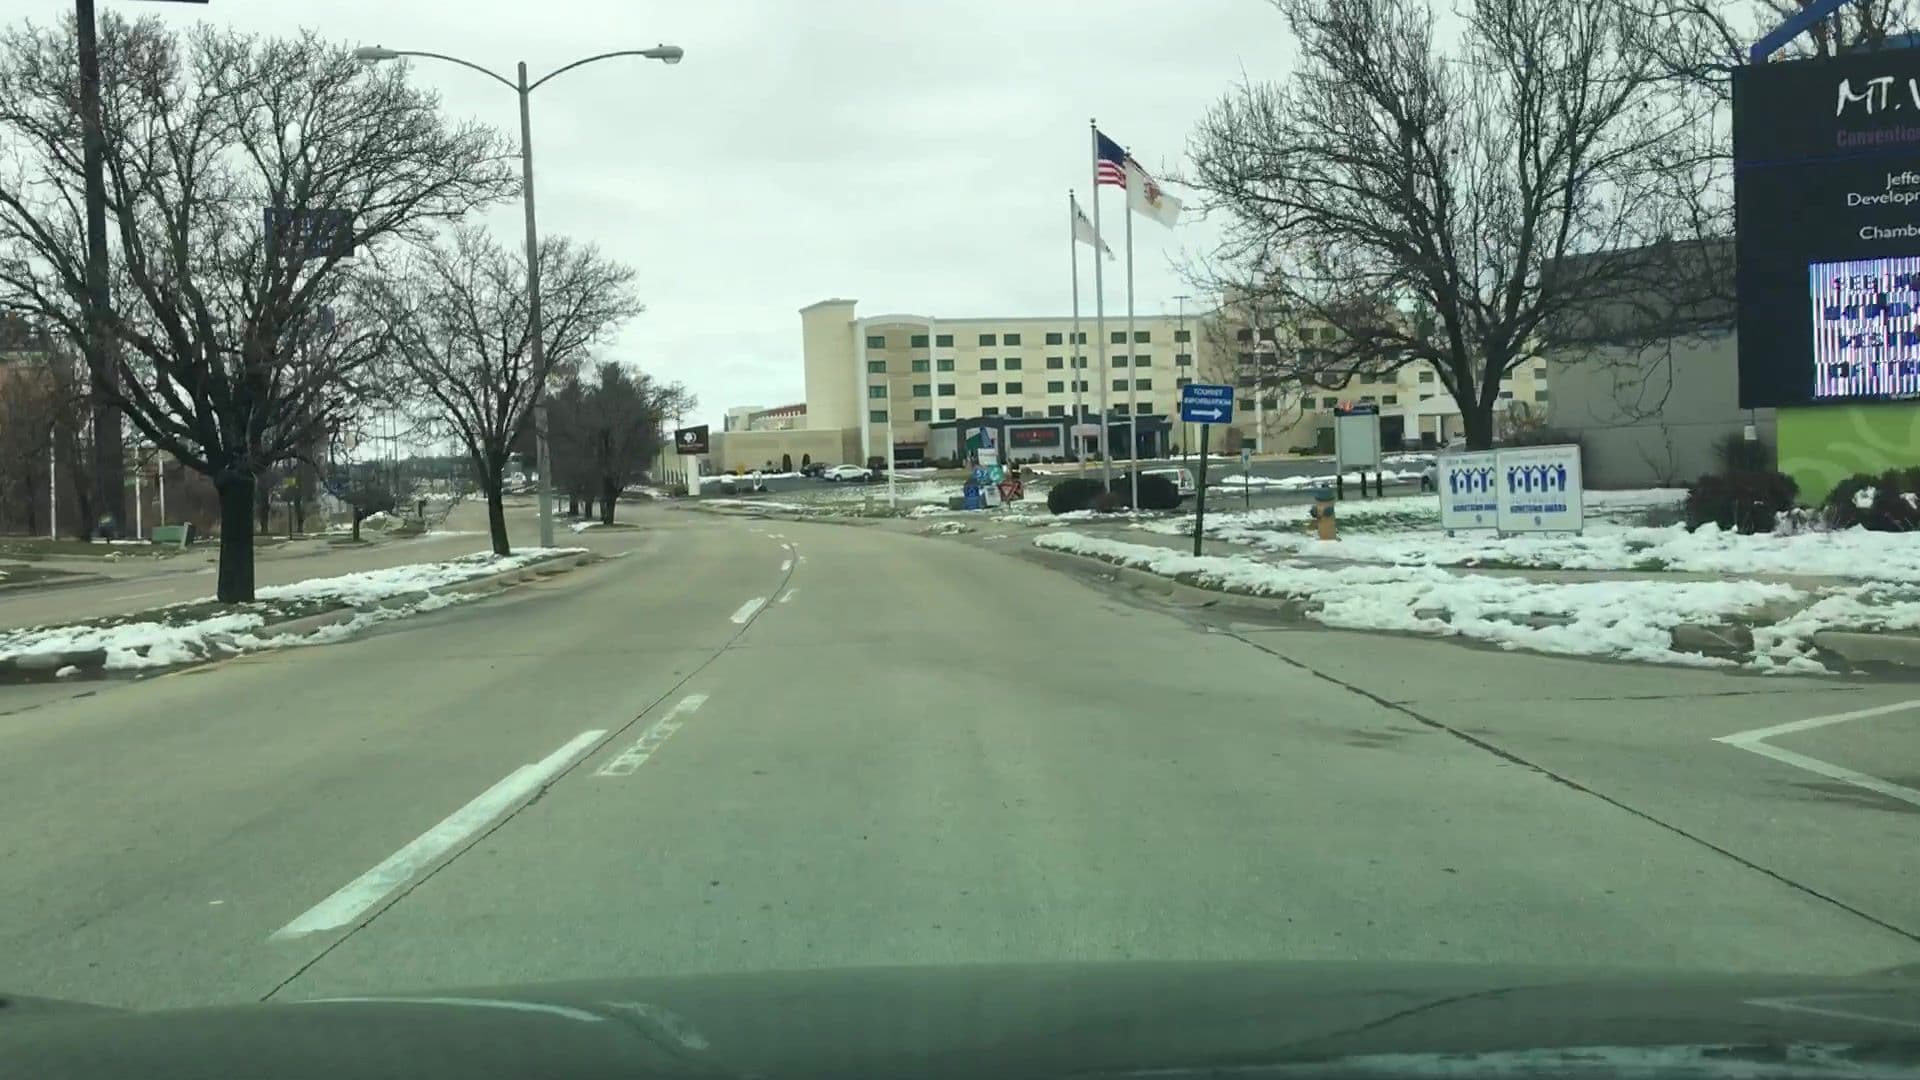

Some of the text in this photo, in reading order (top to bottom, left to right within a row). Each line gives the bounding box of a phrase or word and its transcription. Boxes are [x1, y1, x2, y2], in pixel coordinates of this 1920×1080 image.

[1836, 76, 1901, 117] MT.
[1859, 223, 1920, 240] Chamb
[1193, 388, 1223, 396] TOURIST
